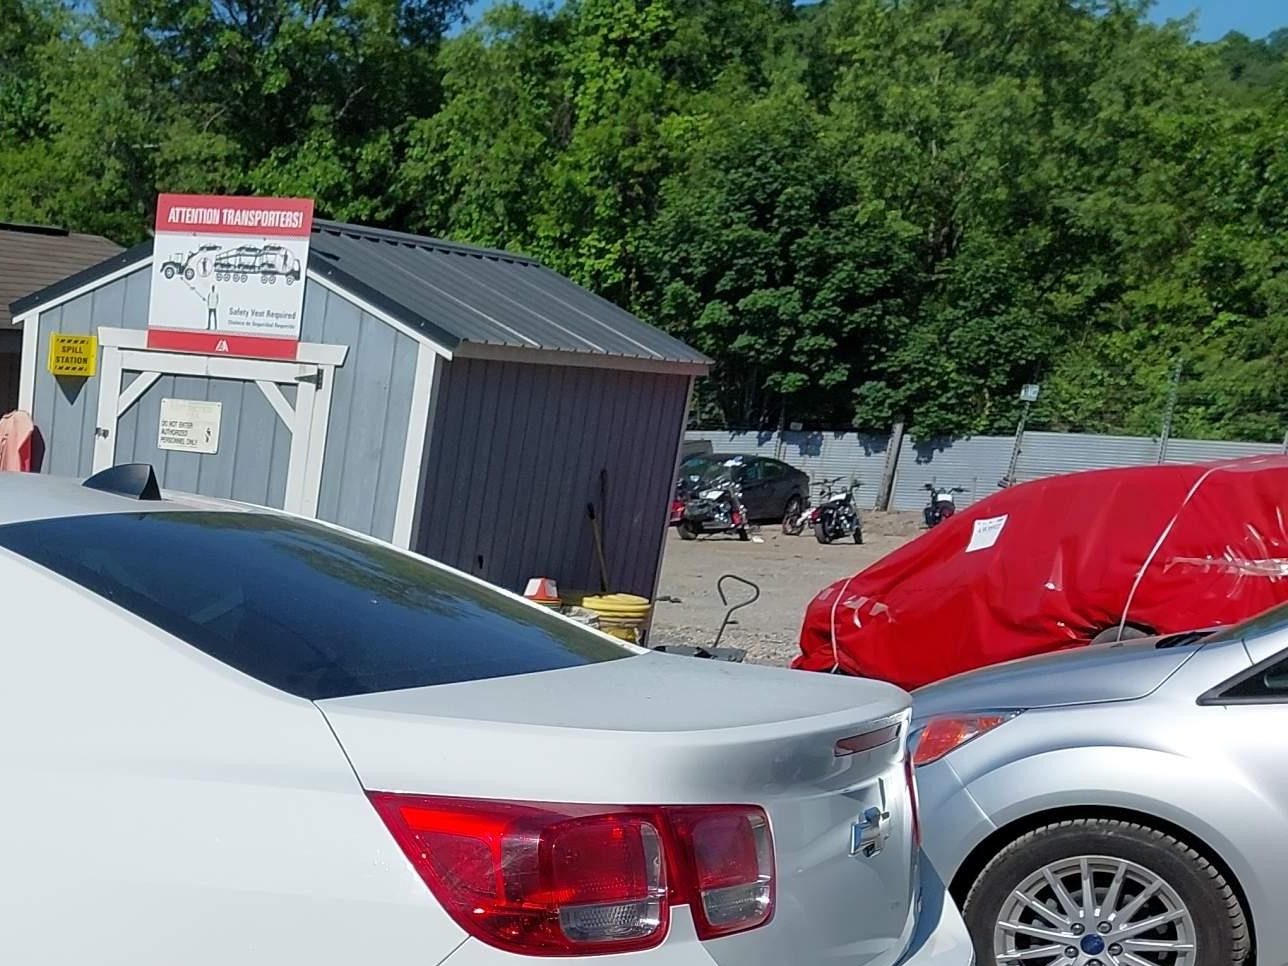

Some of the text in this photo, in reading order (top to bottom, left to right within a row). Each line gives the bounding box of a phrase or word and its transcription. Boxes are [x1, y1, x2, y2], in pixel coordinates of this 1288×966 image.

[168, 207, 304, 228] ATTENTION TRANSPORTERS!
[229, 307, 297, 319] Safety Vest Required
[62, 345, 83, 354] SPILL
[56, 356, 88, 365] STATION
